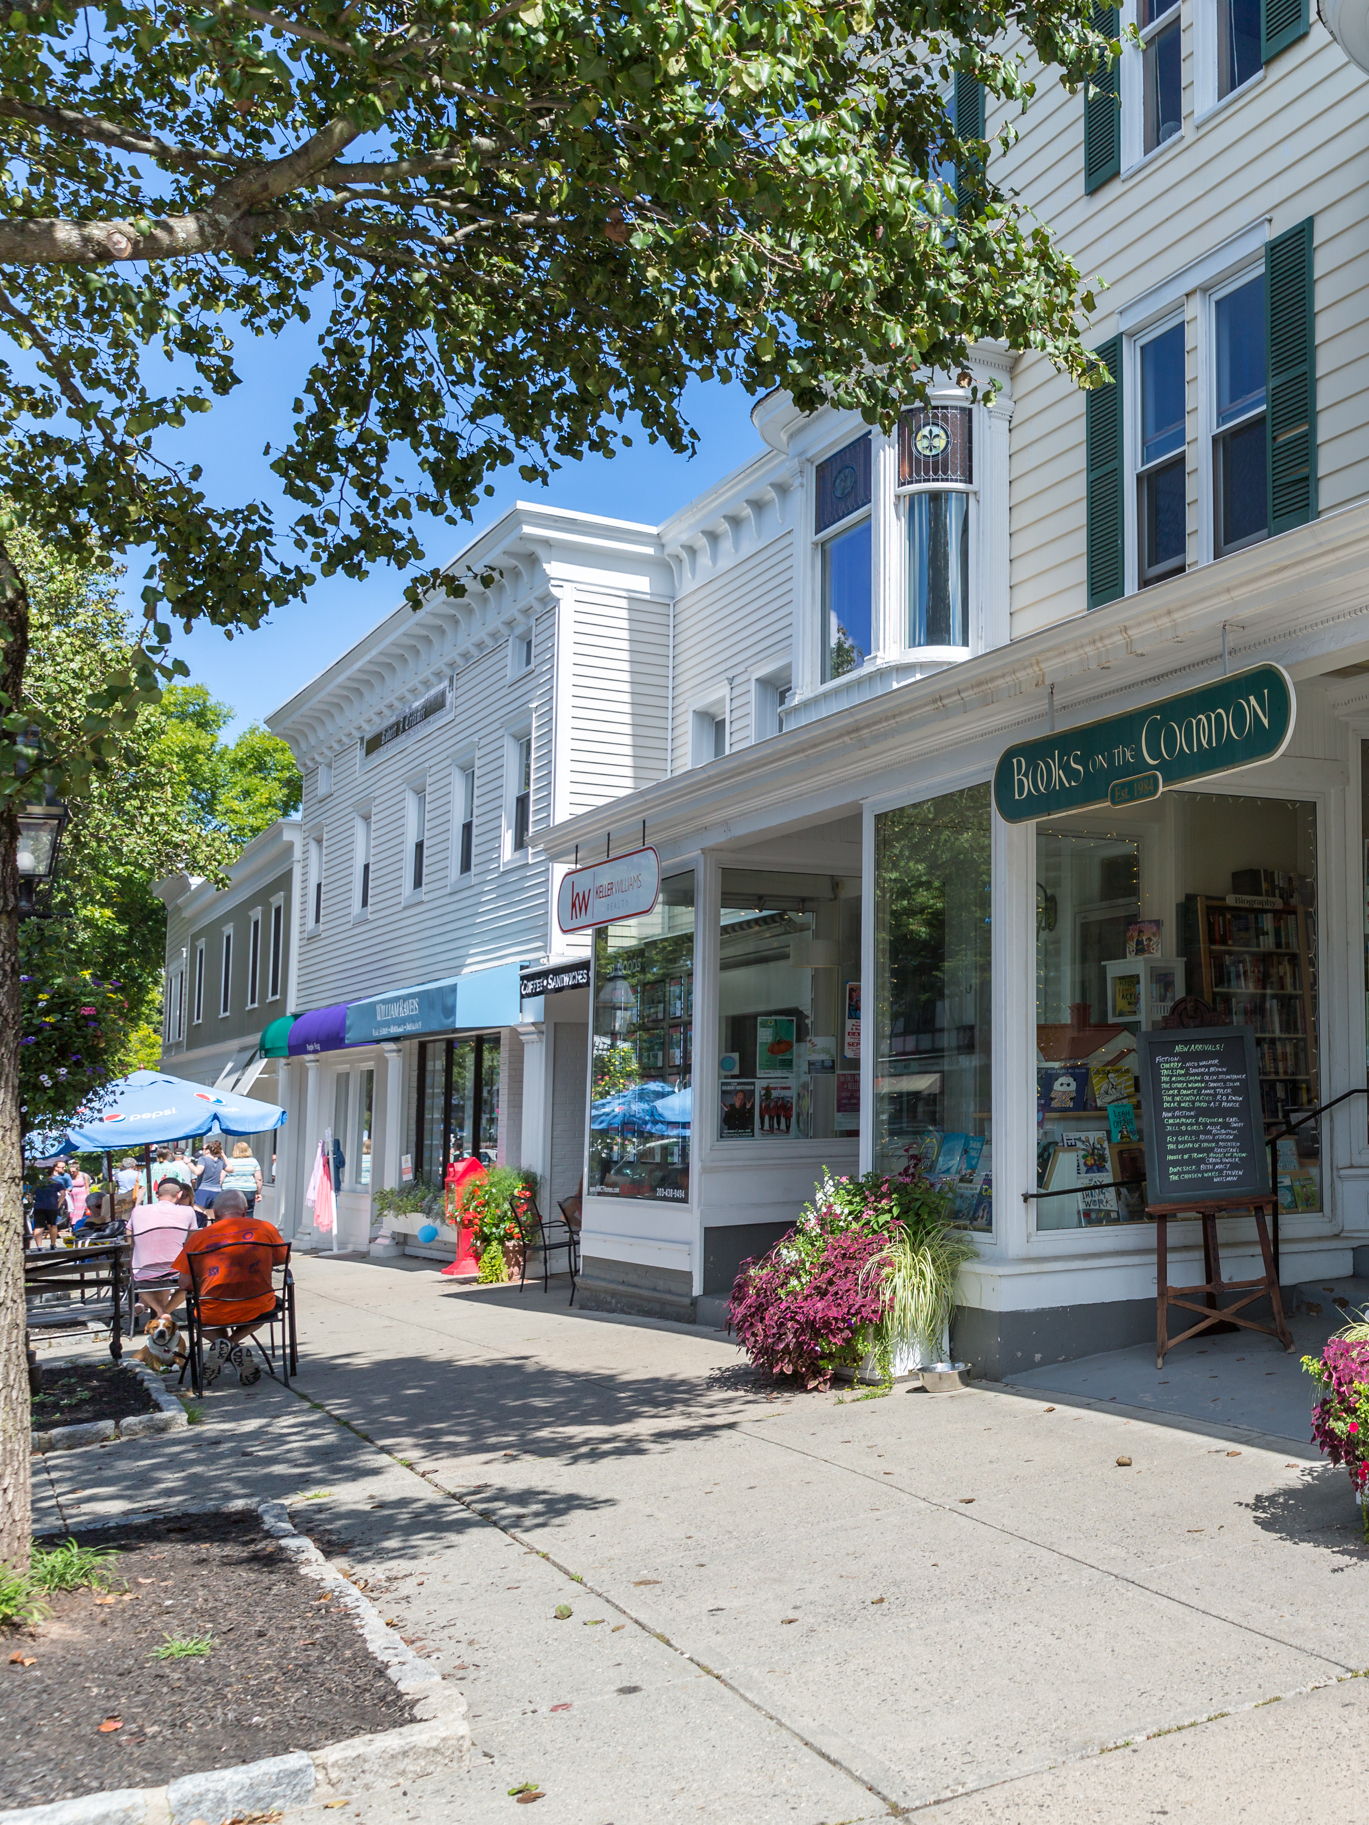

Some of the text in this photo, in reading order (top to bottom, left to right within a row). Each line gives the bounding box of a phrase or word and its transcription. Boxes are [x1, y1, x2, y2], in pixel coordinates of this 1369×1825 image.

[1114, 778, 1154, 802] Est. 1984
[595, 874, 642, 900] KELLER WILLIAMS
[607, 900, 628, 911] REALTY
[1235, 896, 1276, 908] Biography
[548, 970, 587, 989] SANDWICHES
[376, 999, 399, 1021] WILLIAM
[1174, 1044, 1224, 1053] NEW ARRIVALS!
[130, 1107, 178, 1122] pepsi
[1113, 1110, 1130, 1118] LEAH
[1082, 1197, 1113, 1208] WORK
